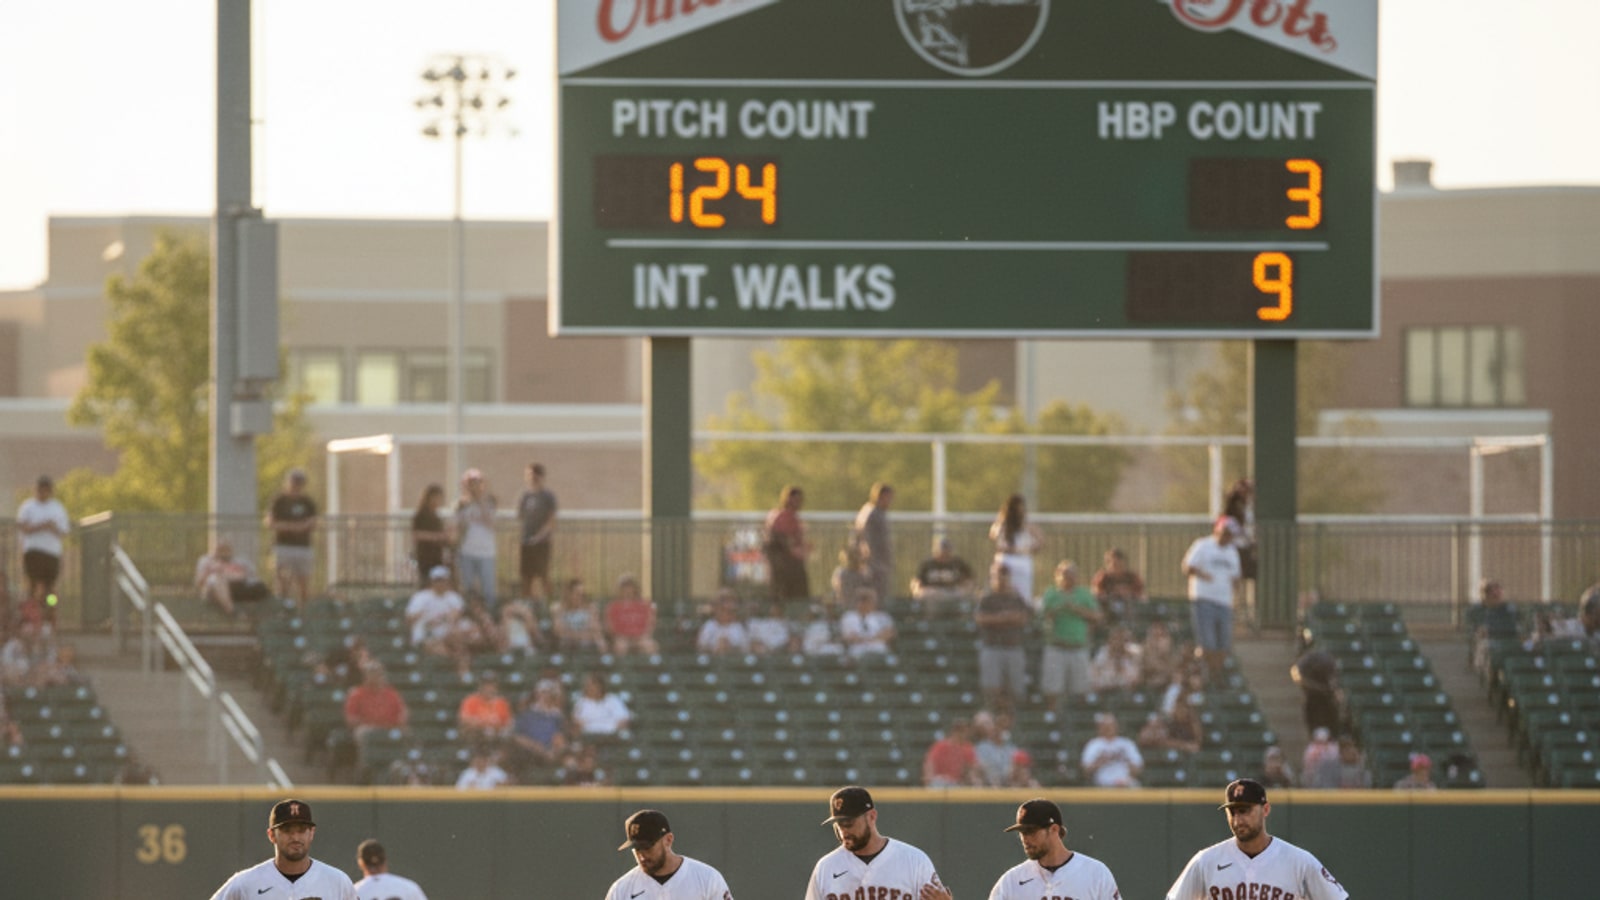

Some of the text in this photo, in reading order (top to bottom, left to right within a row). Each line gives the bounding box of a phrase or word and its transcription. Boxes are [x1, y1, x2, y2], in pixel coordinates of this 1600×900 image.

[612, 99, 874, 138] PITCH COUNT
[1098, 101, 1322, 139] HBP COUNT
[668, 157, 778, 229] 124
[1285, 158, 1323, 230] 3
[633, 264, 896, 311] INT. WALKS
[1252, 252, 1293, 322] 9
[136, 825, 187, 864] 36
